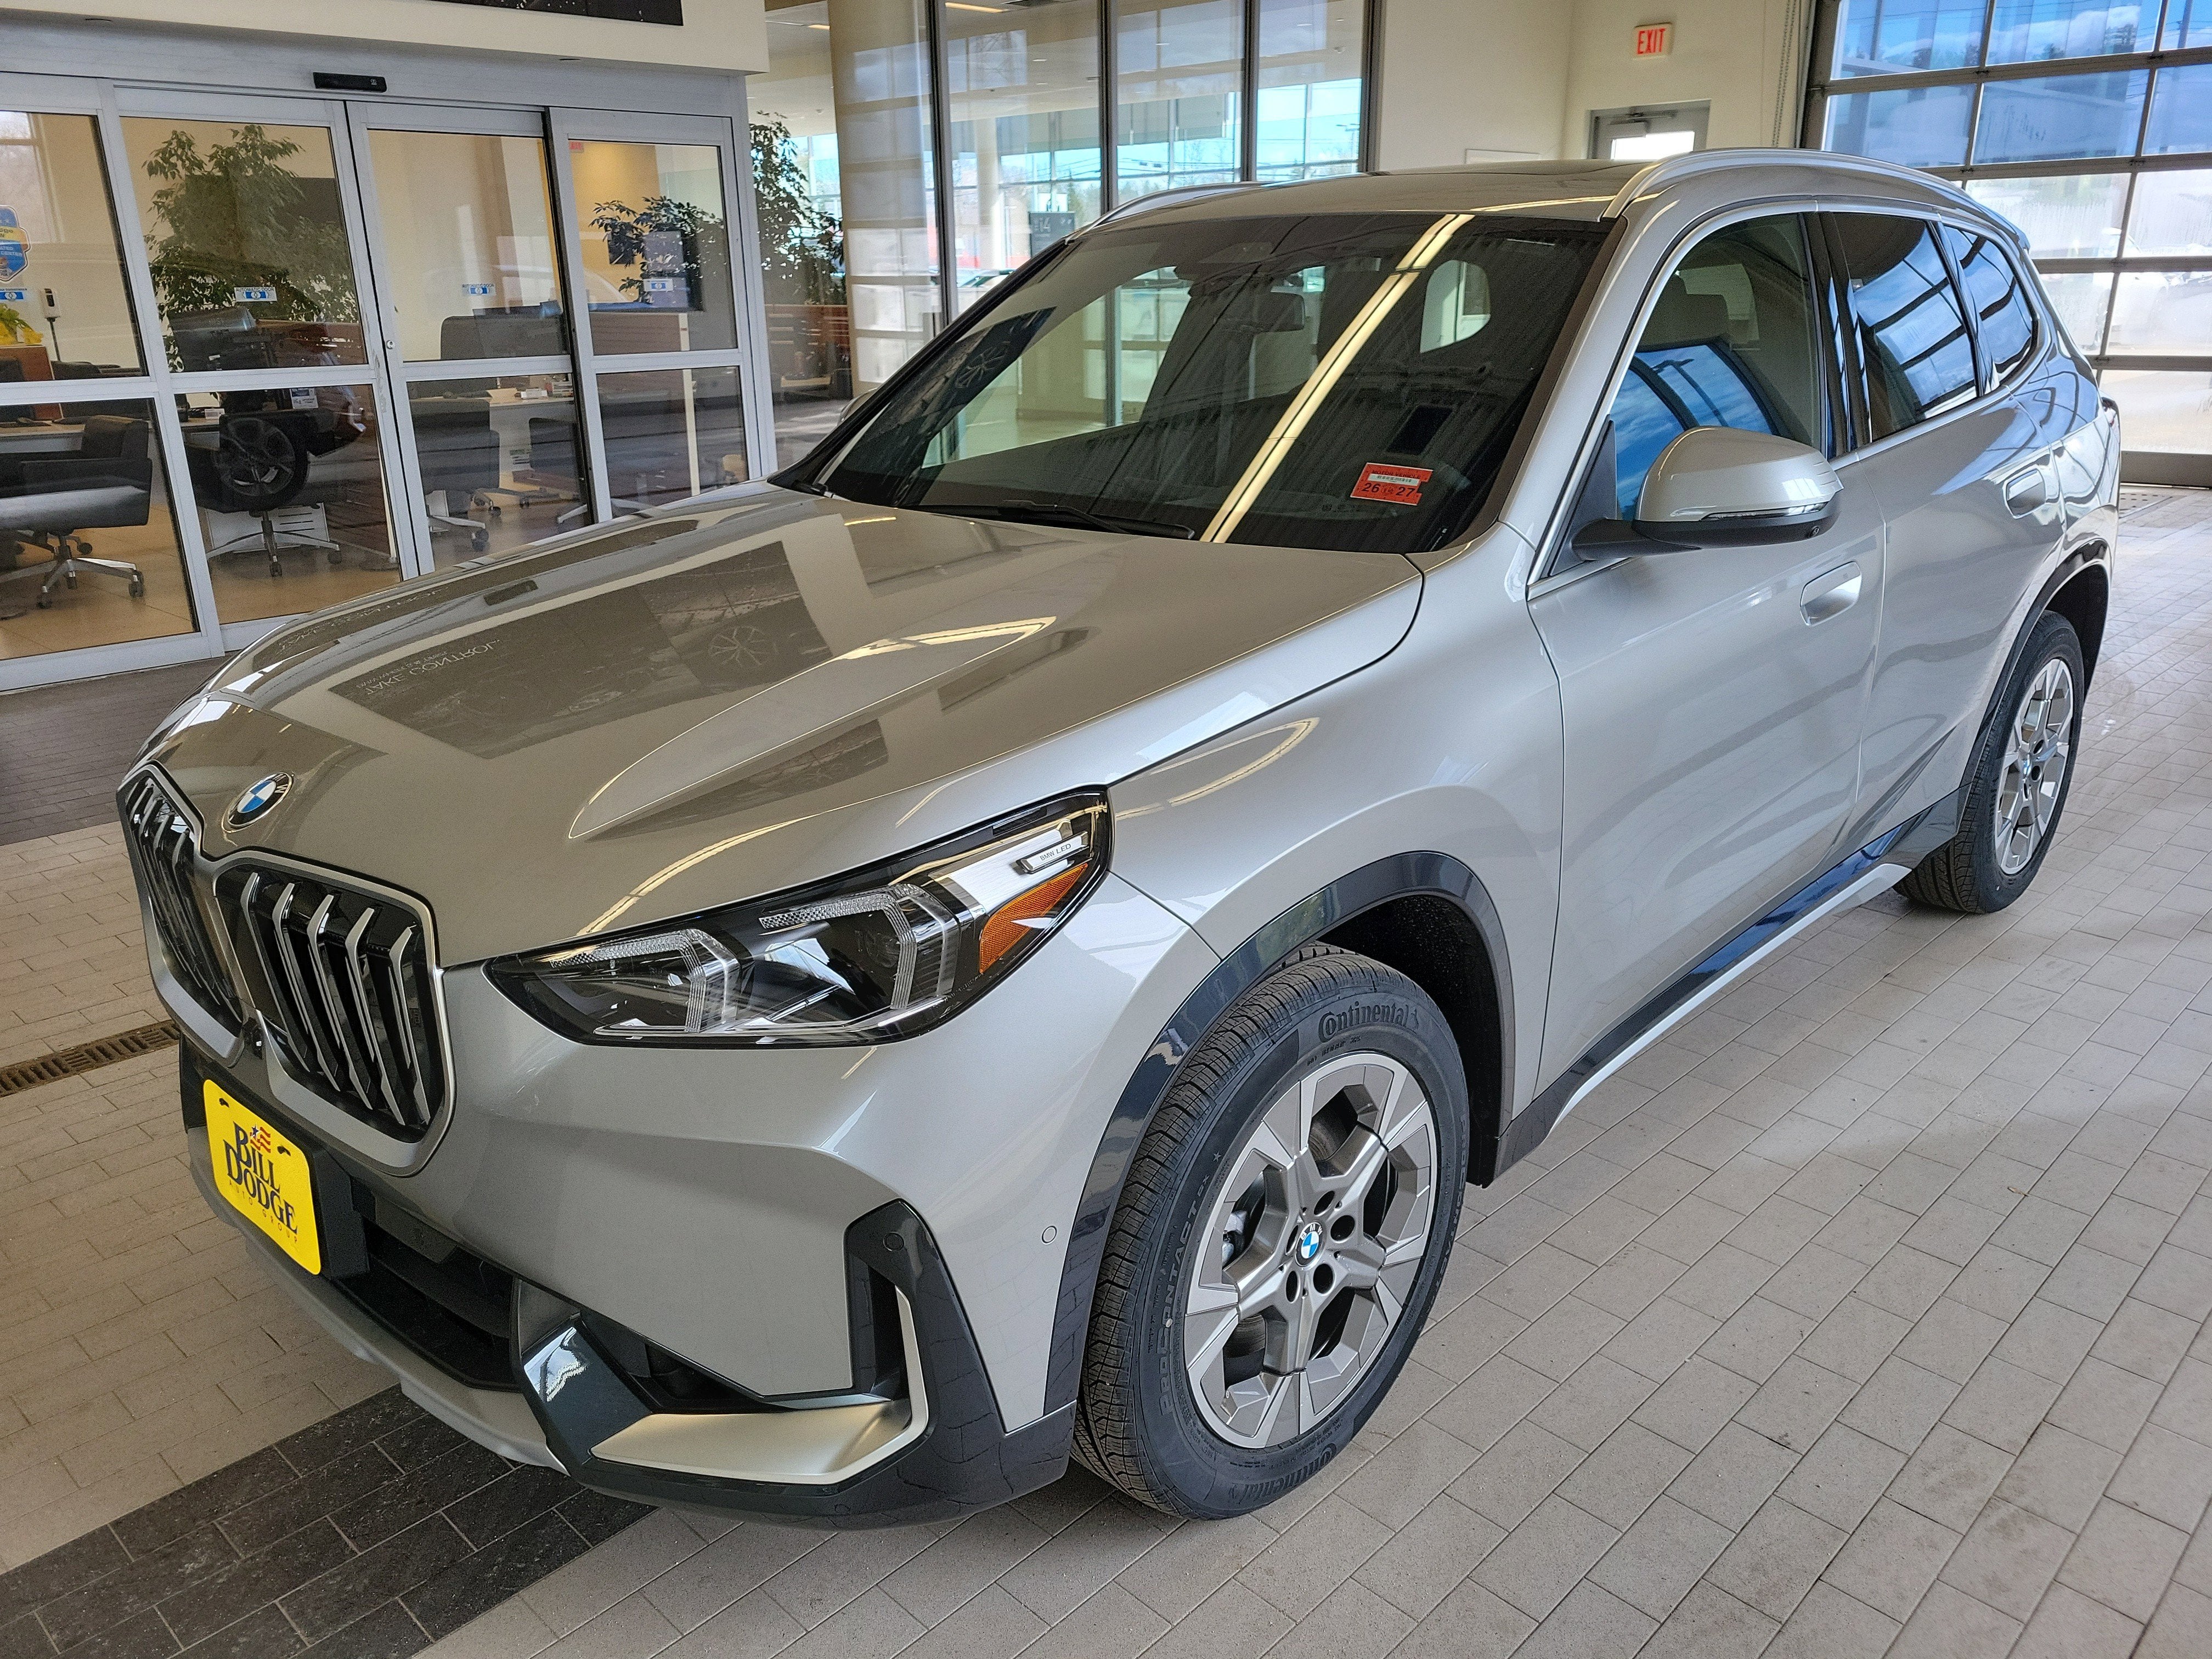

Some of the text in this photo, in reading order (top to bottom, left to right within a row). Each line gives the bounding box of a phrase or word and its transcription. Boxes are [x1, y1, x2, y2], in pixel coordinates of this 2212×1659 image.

[1638, 28, 1666, 54] EXIT
[1361, 482, 1415, 497] 26 27
[1040, 843, 1071, 861] BMW LED
[1318, 1001, 1409, 1043] Continental
[233, 1121, 281, 1193] BILL
[223, 1139, 298, 1234] DODGE
[229, 1181, 298, 1244] AUTO GROUP
[1300, 1223, 1323, 1240] BMW
